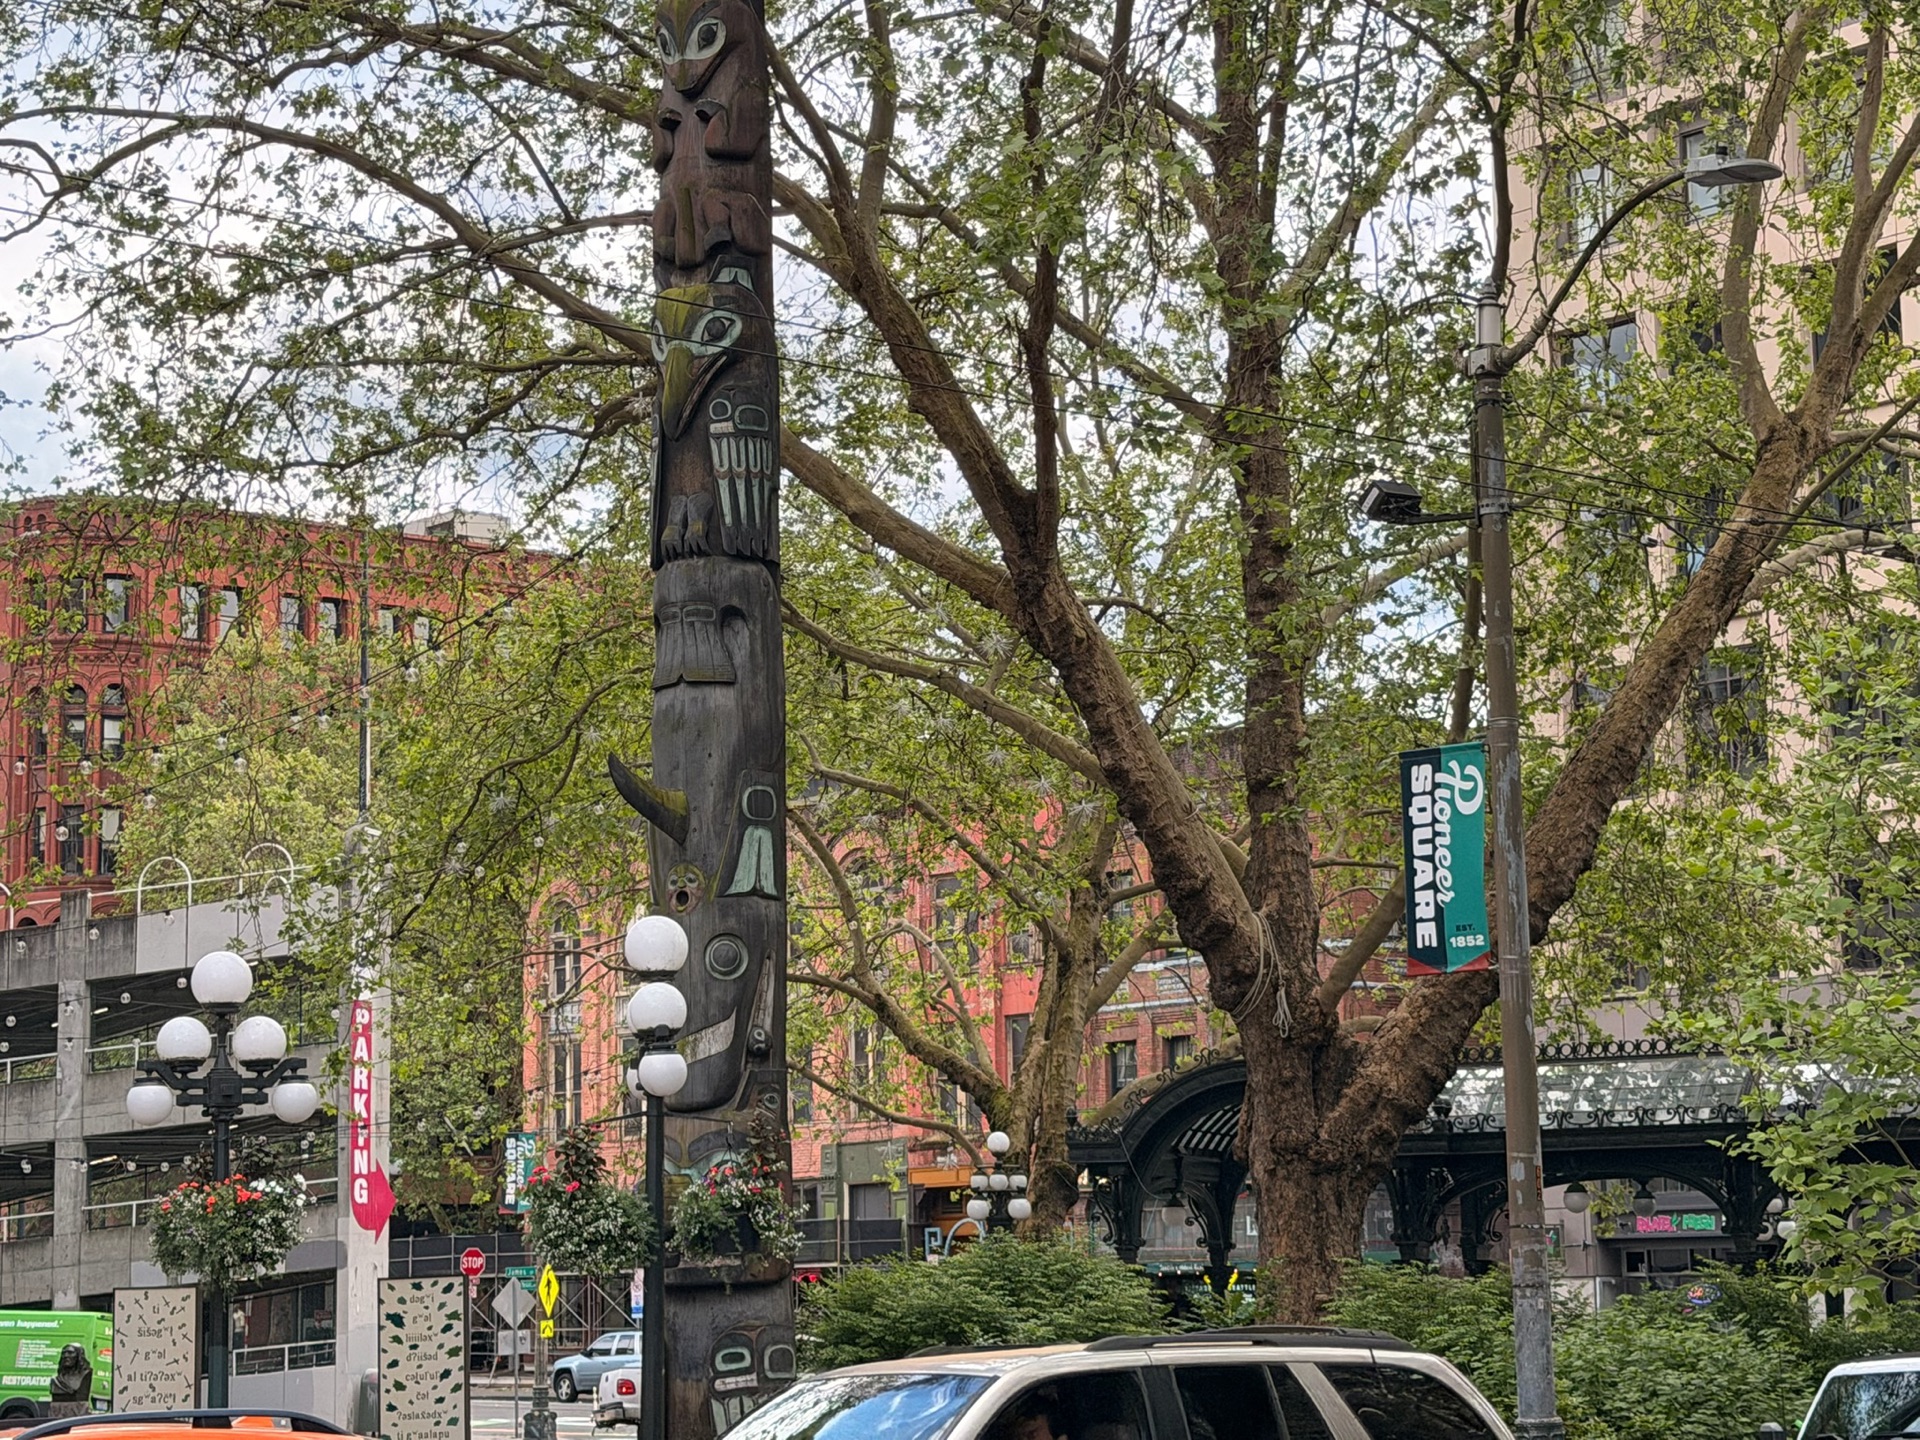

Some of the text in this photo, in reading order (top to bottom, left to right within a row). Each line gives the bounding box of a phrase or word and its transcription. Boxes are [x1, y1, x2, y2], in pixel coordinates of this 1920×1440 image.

[1408, 763, 1438, 949] SQUARE
[1434, 760, 1484, 908] Pioneer
[1449, 934, 1485, 948] 1852
[1455, 923, 1476, 933] EST.
[353, 1007, 371, 1205] PARKING
[462, 1256, 484, 1269] STOP
